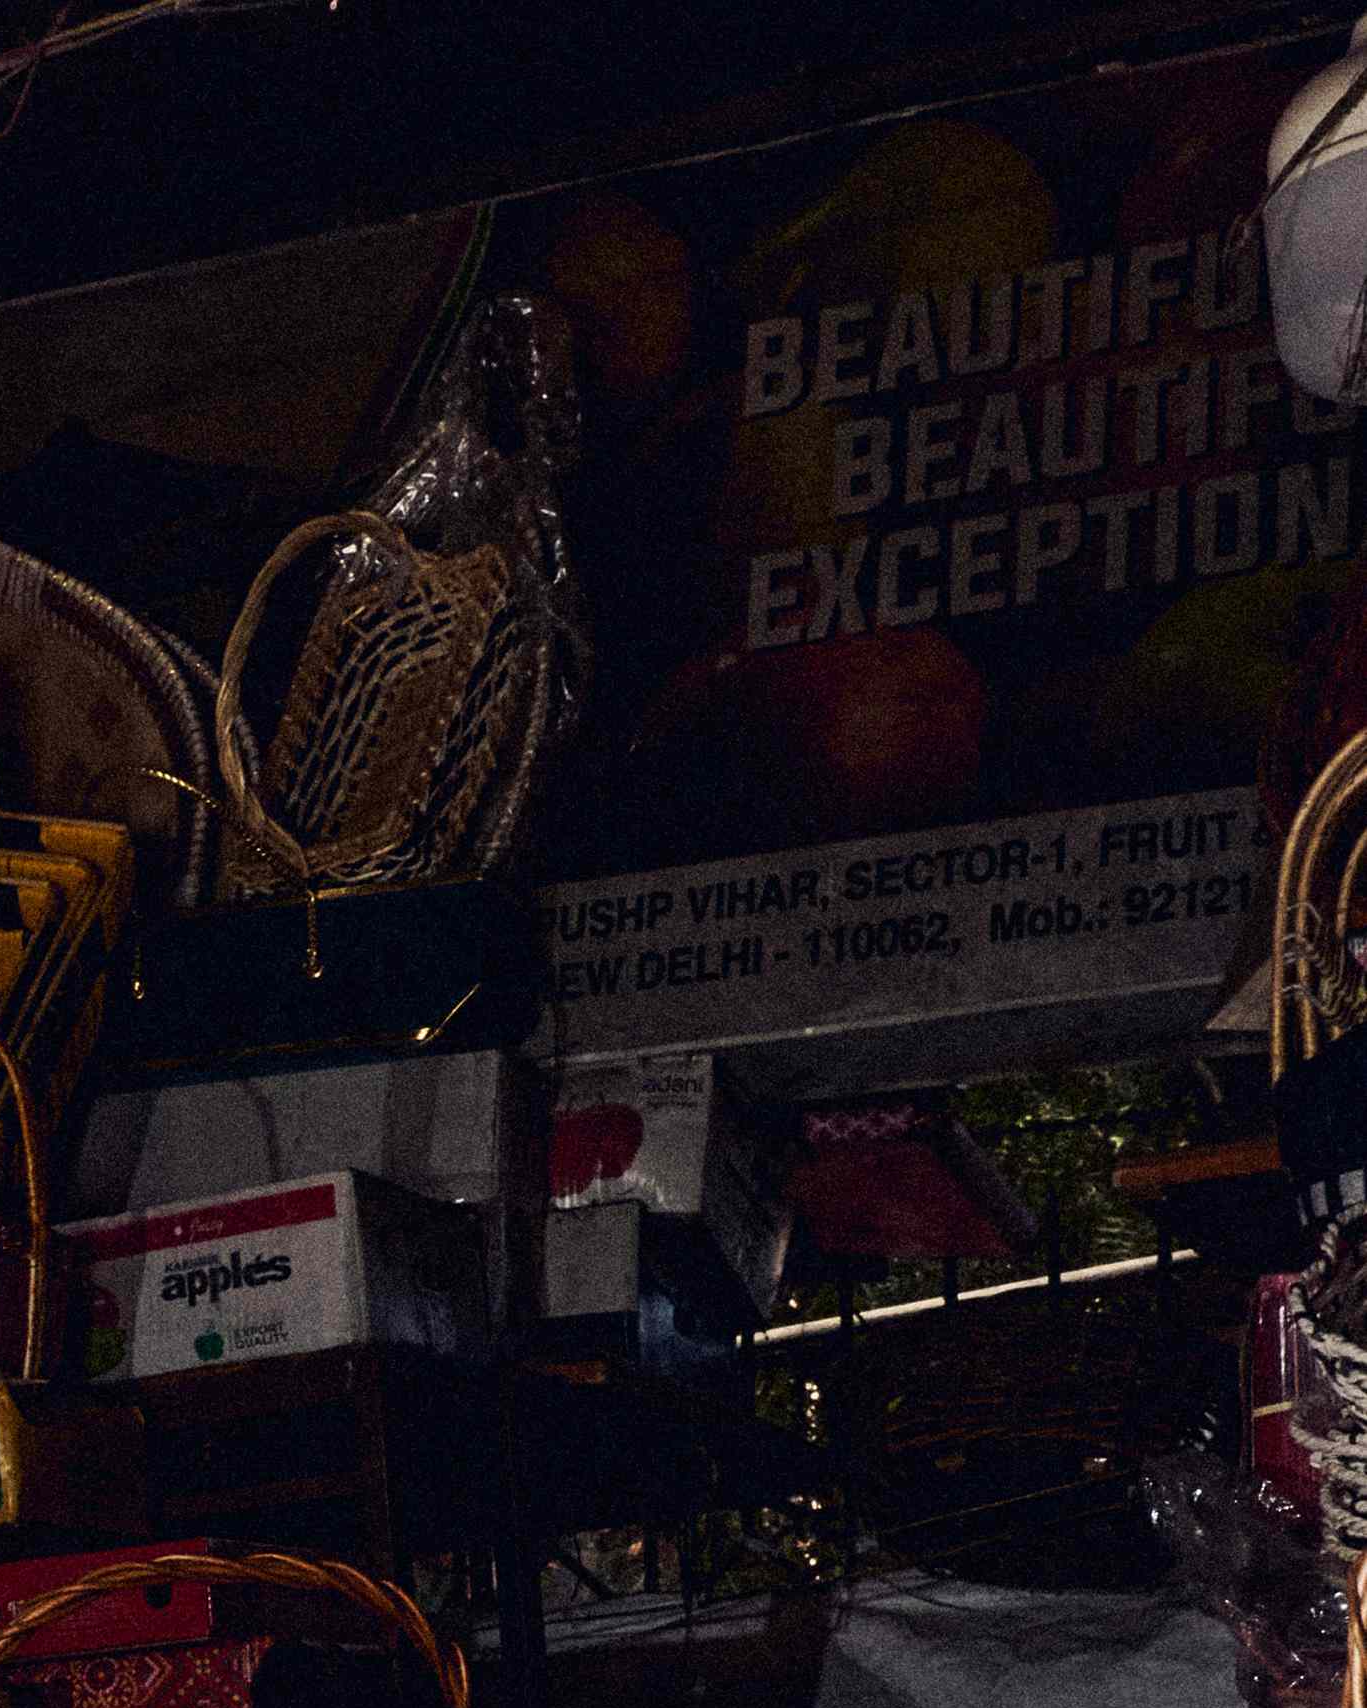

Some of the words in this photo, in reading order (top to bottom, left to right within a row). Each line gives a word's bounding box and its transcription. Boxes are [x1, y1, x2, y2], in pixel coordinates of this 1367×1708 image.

[687, 870, 830, 925] VIHAR,
[845, 833, 1084, 901] SECTOR-1,
[1099, 811, 1239, 866] FRUIT
[636, 936, 763, 990] DELHI
[803, 912, 962, 966] 110062,
[161, 1250, 292, 1307] apples
